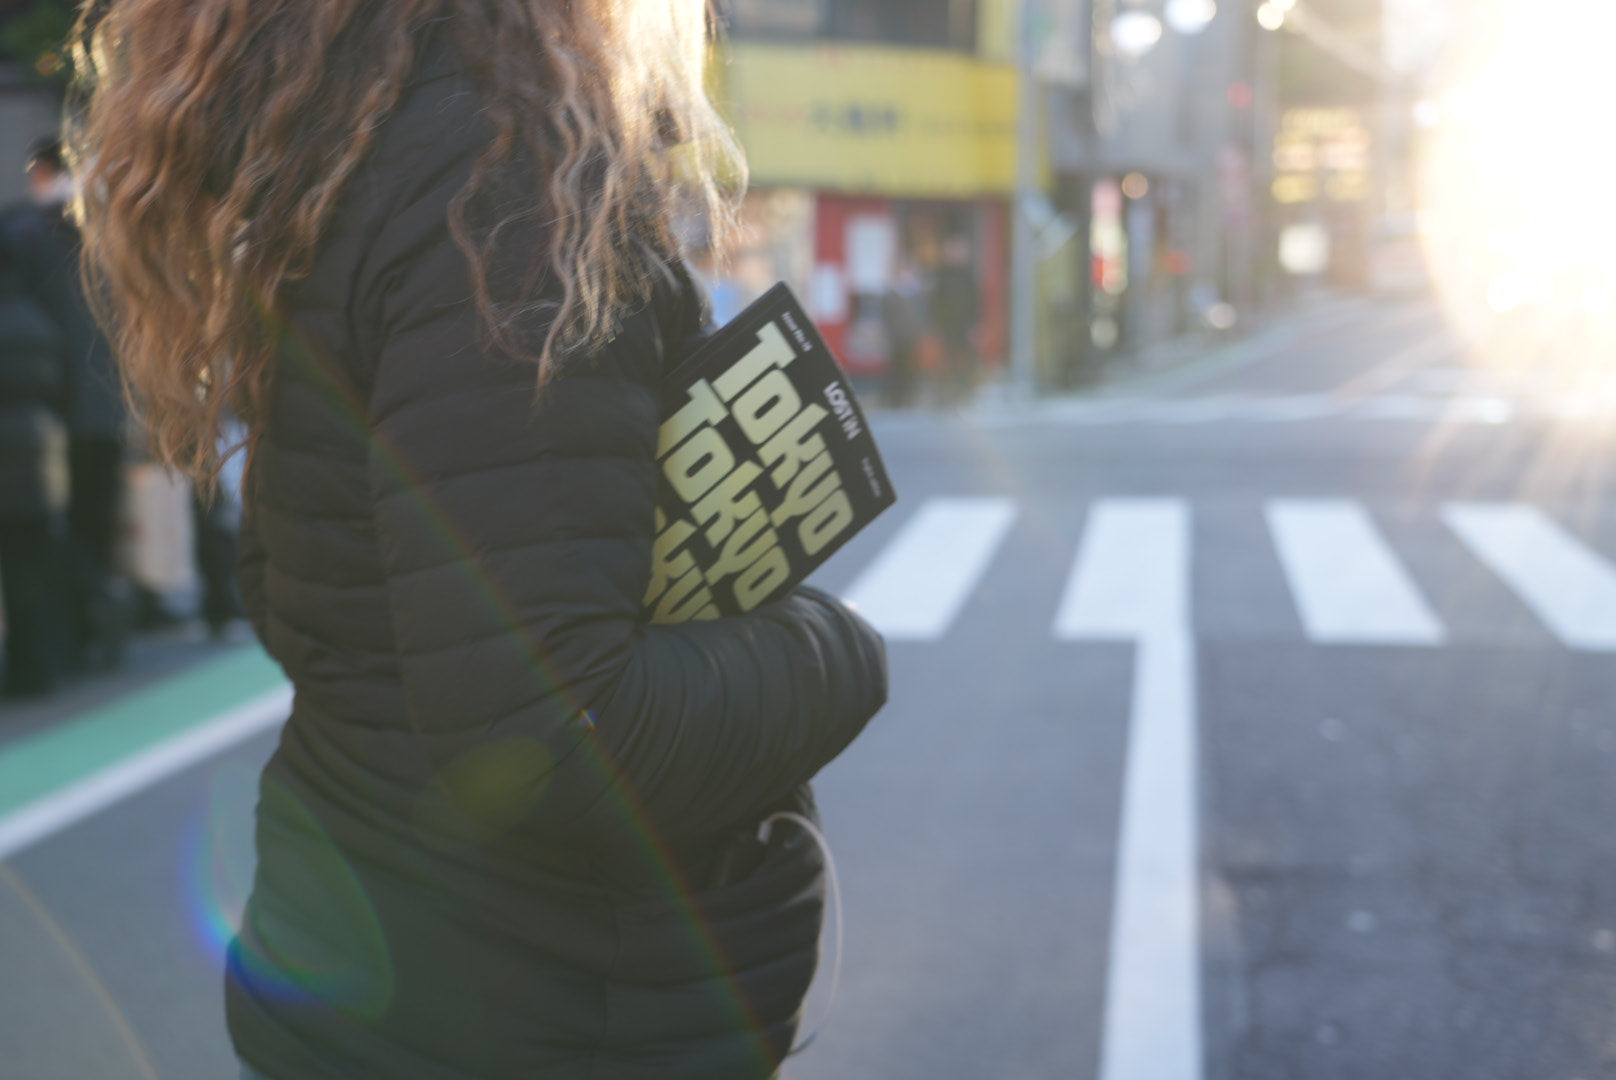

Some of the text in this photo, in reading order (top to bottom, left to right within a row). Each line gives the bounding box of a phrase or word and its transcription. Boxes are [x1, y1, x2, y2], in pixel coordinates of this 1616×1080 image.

[655, 378, 790, 612] Tokyo
[711, 321, 854, 556] Tokyo
[824, 381, 853, 423] LOST
